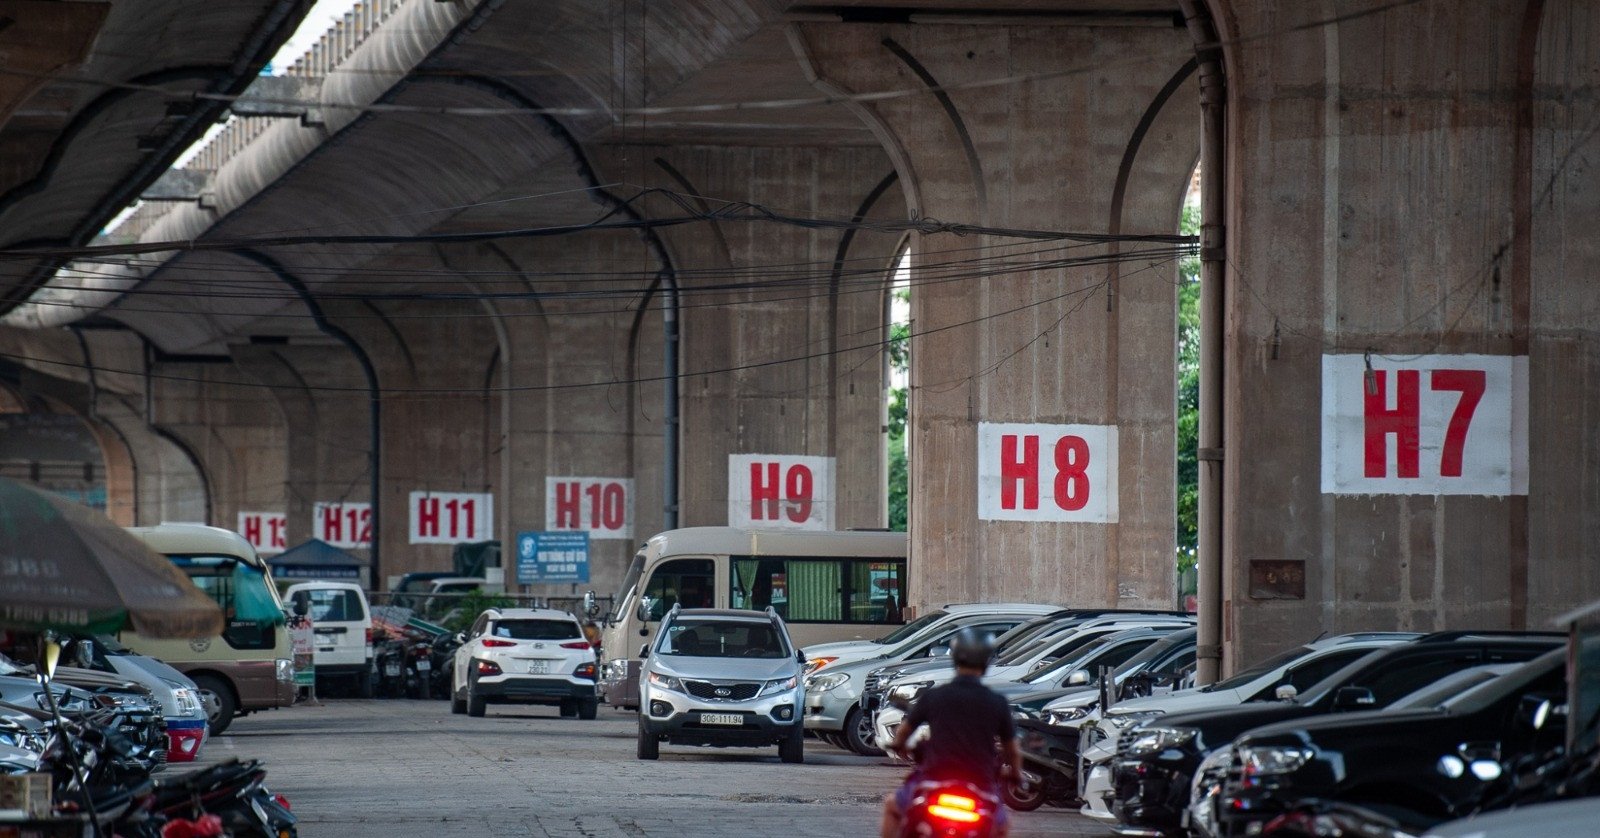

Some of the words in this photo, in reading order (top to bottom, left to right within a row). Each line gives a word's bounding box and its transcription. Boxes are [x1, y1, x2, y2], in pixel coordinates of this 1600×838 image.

[1364, 369, 1487, 478] H7
[750, 462, 814, 524] H9
[1000, 434, 1091, 511] H8
[323, 507, 371, 543] H12
[419, 497, 476, 540] H11
[556, 481, 625, 530] H10
